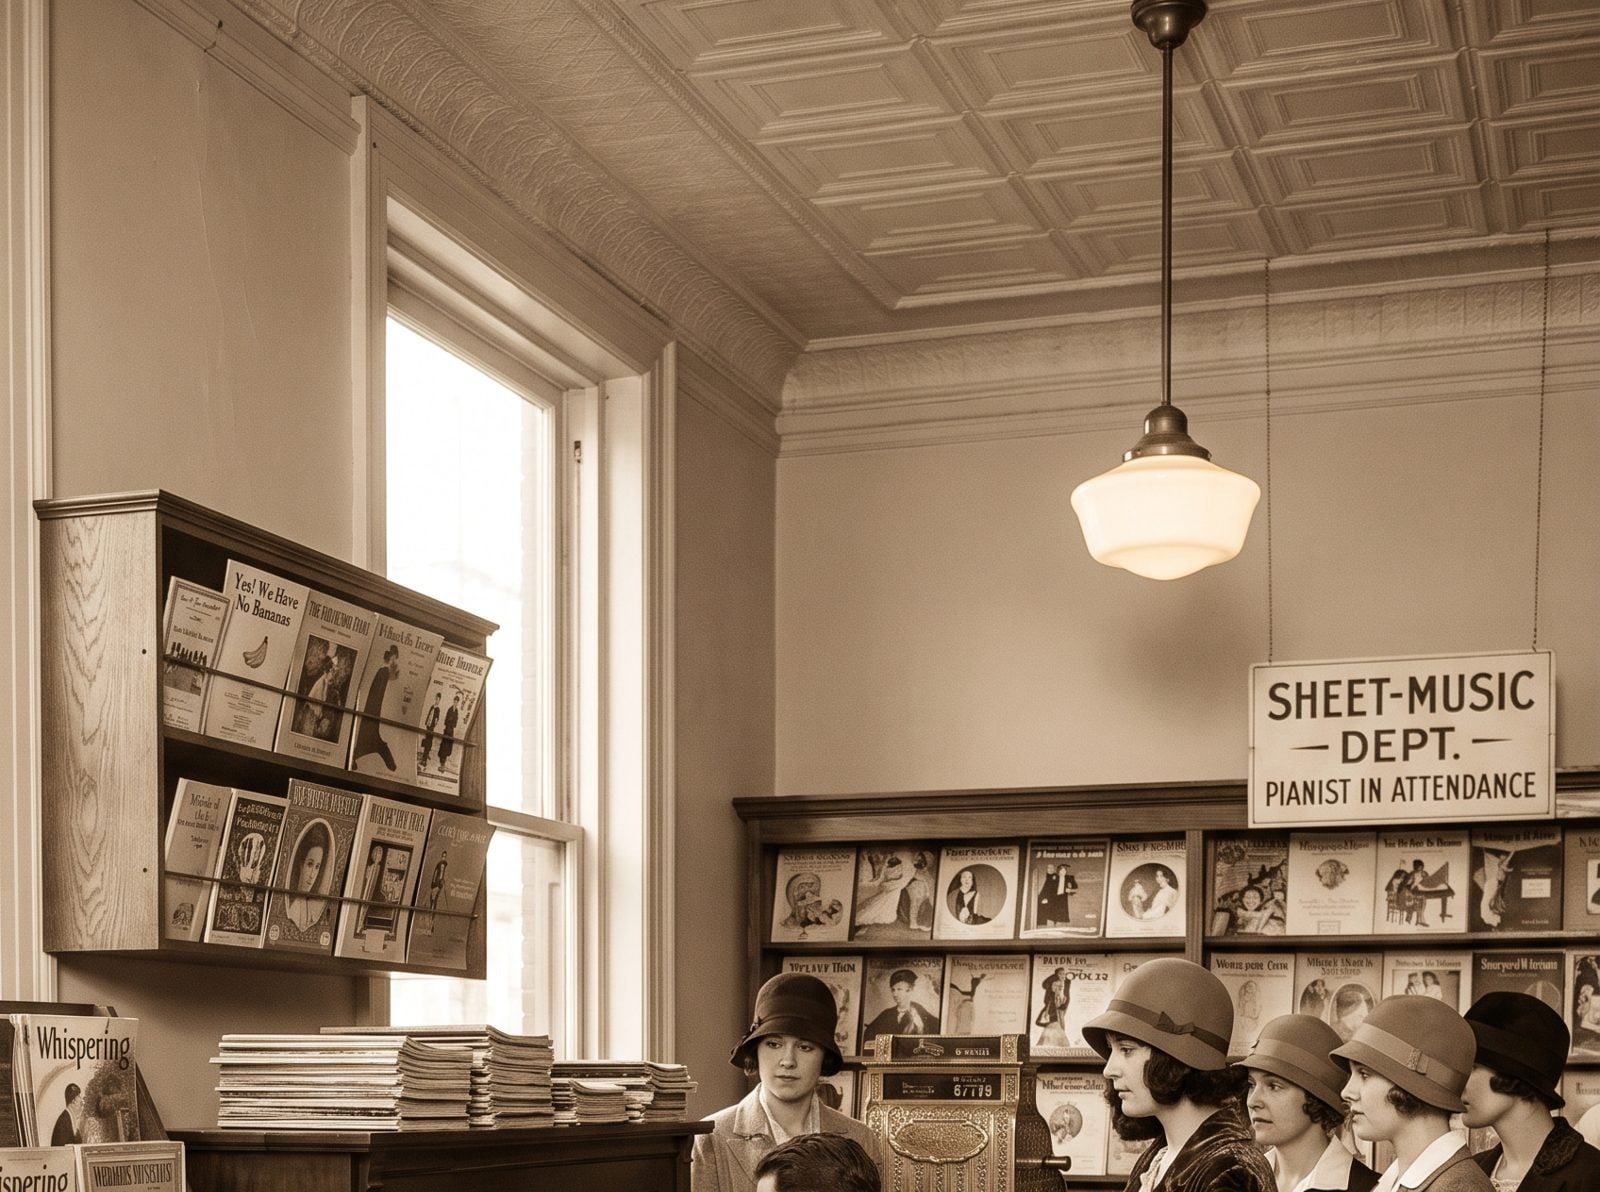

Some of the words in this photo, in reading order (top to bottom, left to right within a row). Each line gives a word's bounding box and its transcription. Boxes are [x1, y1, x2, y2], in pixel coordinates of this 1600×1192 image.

[235, 571, 257, 595] Yes!
[259, 580, 274, 601] We
[274, 587, 299, 610] Have
[235, 593, 250, 613] No
[252, 599, 291, 627] Bananas
[1267, 670, 1536, 721] SHEET-MUSIC
[1341, 726, 1460, 764] DEPT.
[1266, 778, 1352, 807] PIANIST
[1360, 776, 1382, 803] IN
[1391, 771, 1537, 803] ATTENDANCE
[37, 1025, 131, 1070] Whispering
